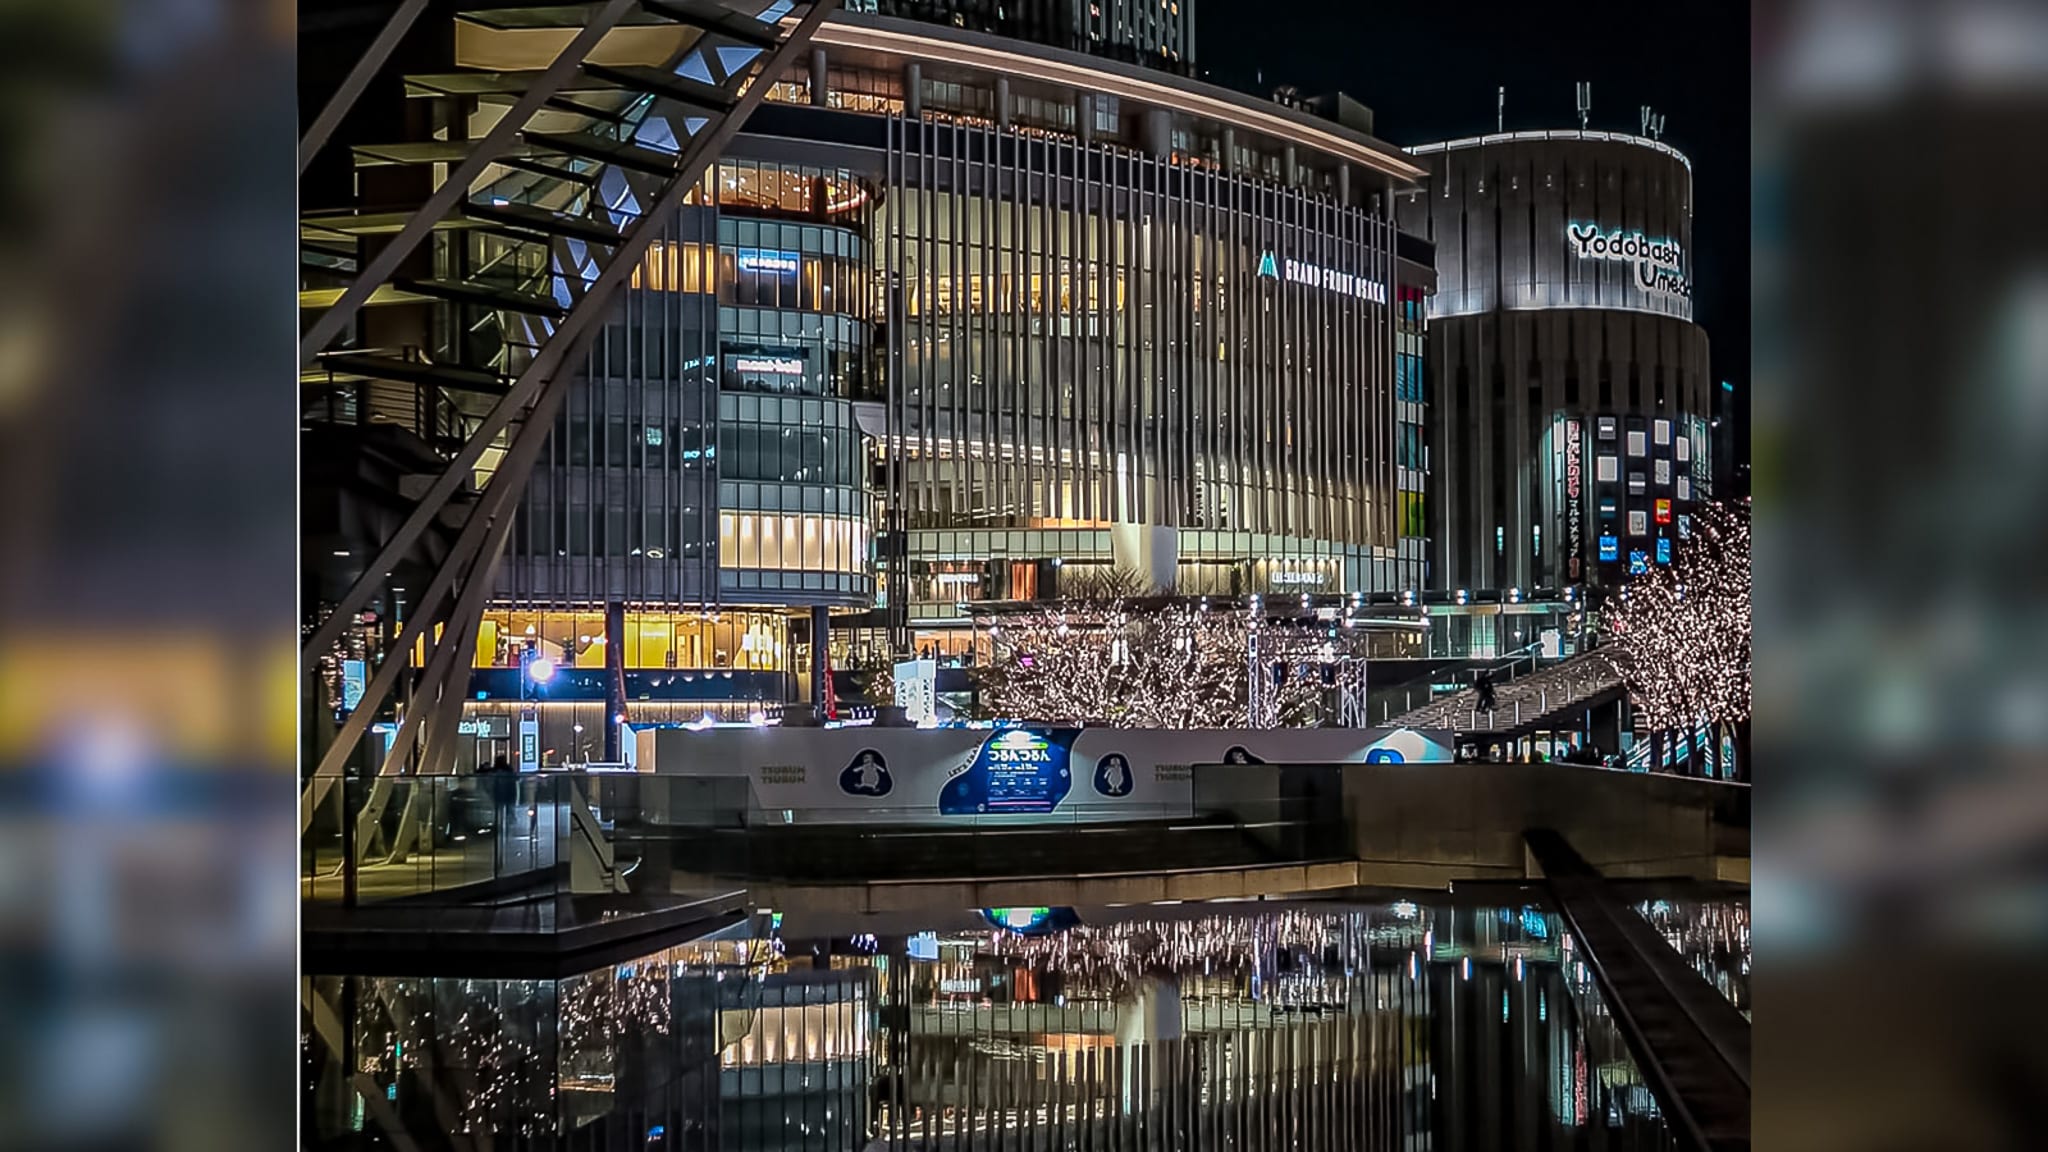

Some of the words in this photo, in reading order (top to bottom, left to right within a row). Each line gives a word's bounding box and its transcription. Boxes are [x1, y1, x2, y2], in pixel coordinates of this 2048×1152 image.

[1285, 259, 1320, 287] GRAND
[1323, 268, 1353, 295] FRONT
[1355, 277, 1385, 304] OSAKA
